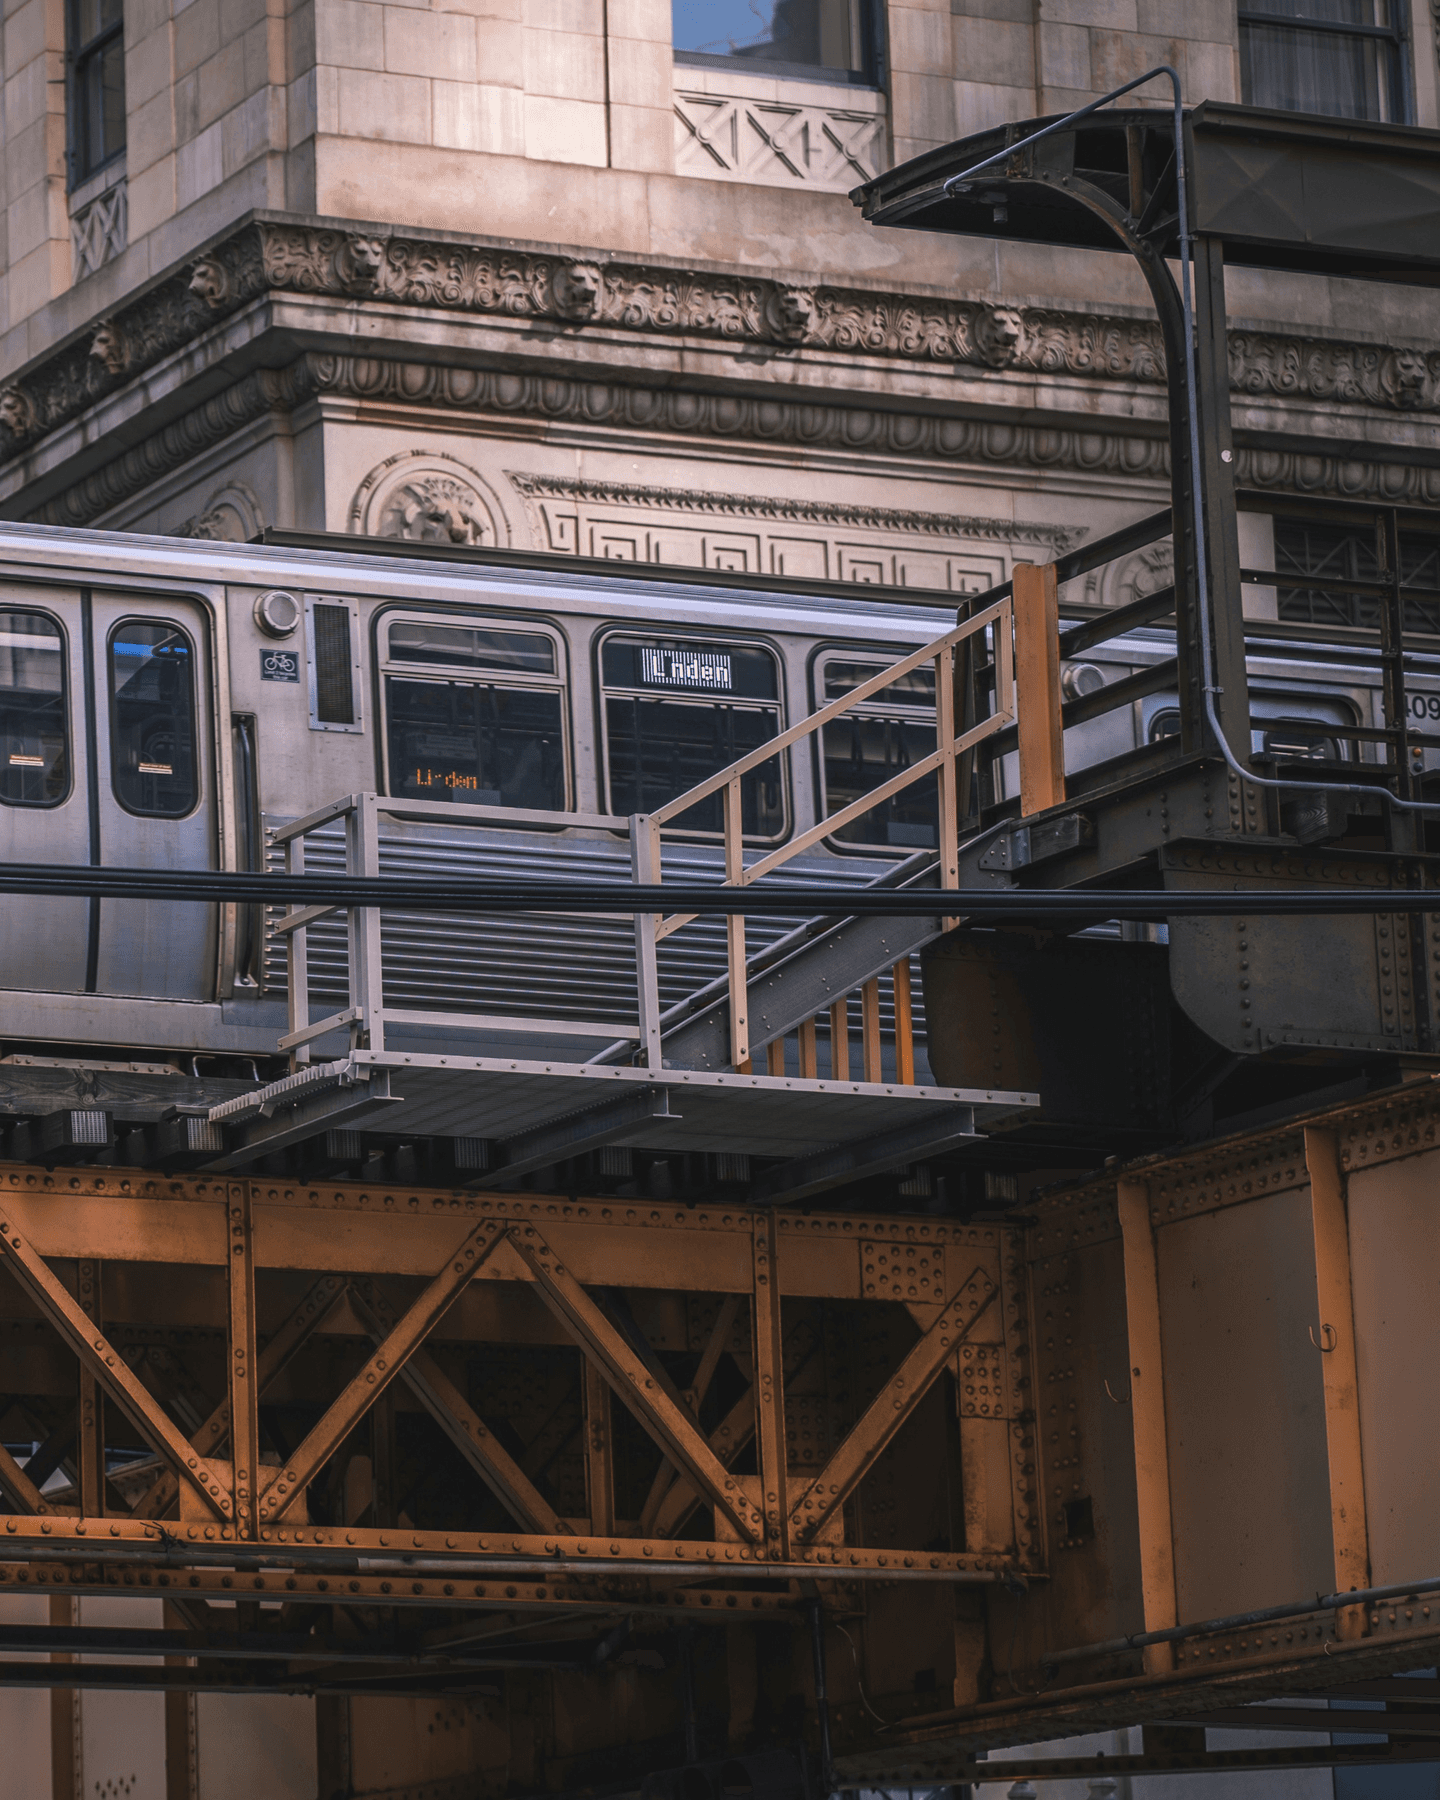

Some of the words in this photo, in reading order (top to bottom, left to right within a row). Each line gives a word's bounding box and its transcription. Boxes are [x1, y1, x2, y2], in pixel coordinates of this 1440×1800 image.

[652, 655, 728, 682] Lnden
[1381, 694, 1440, 720] 09
[417, 768, 477, 790] Liden
